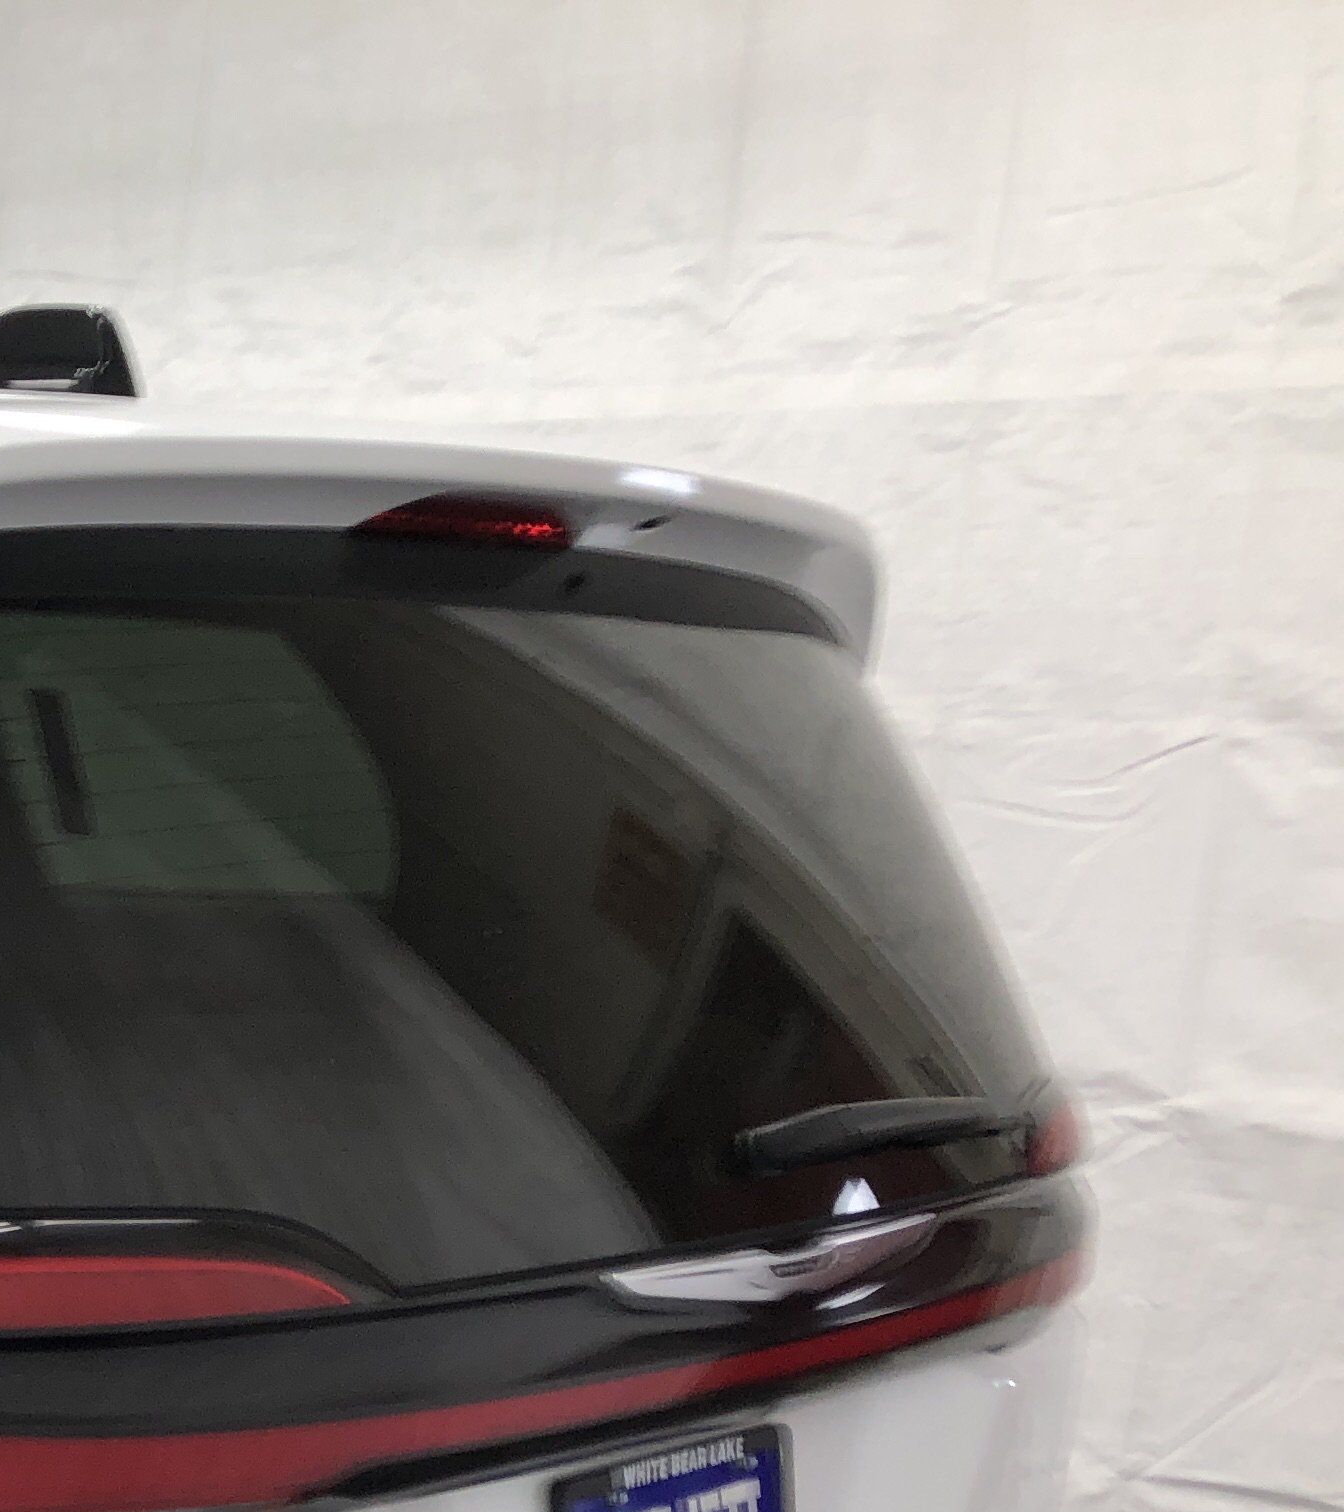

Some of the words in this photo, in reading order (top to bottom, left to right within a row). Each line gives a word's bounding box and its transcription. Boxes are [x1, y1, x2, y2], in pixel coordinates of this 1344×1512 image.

[622, 1456, 669, 1490] WHITE
[671, 1445, 707, 1478] BEAR
[708, 1436, 745, 1467] LAKE
